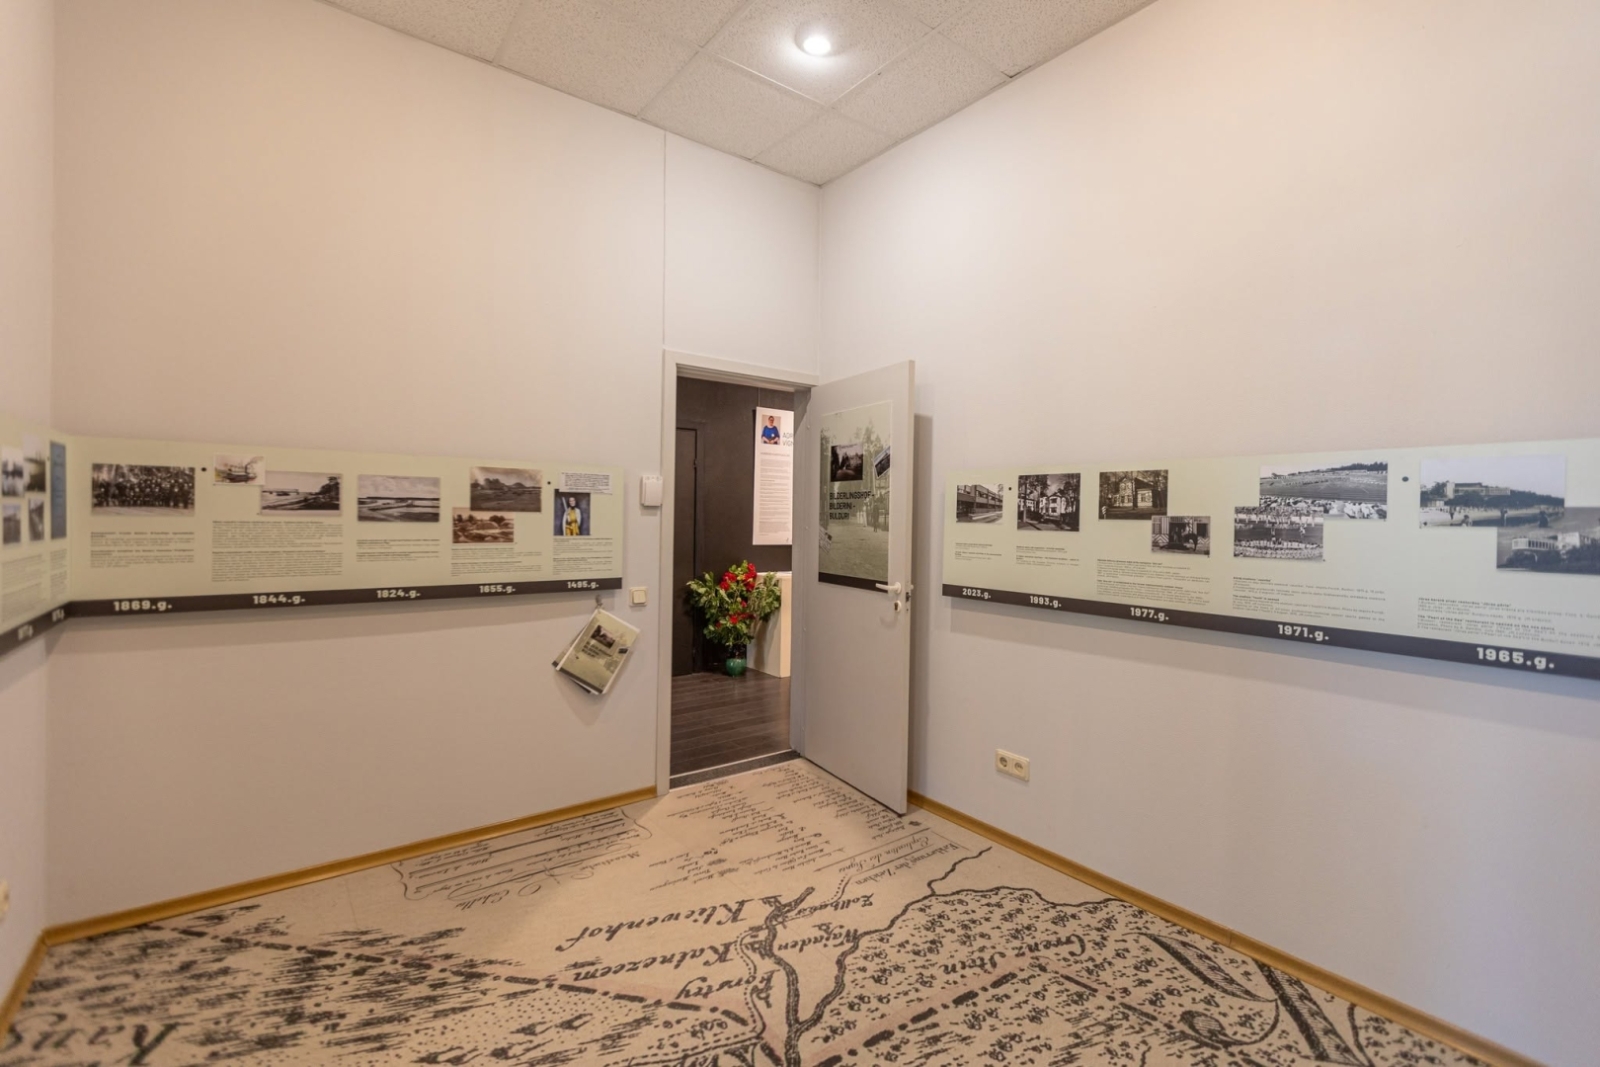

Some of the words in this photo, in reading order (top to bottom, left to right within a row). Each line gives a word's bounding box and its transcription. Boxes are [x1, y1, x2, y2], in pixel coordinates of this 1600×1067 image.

[253, 594, 306, 604] 1844.g.
[376, 589, 421, 598] 1824.g.
[962, 588, 991, 599] 2023.g.
[113, 600, 172, 612] 1869.g.
[1030, 596, 1062, 608] 1993.g.
[1130, 607, 1169, 622] 1977.g.
[1278, 624, 1330, 641] 1971.g.
[1476, 647, 1555, 670] 1965.g.
[554, 899, 754, 952] Kliewenhof
